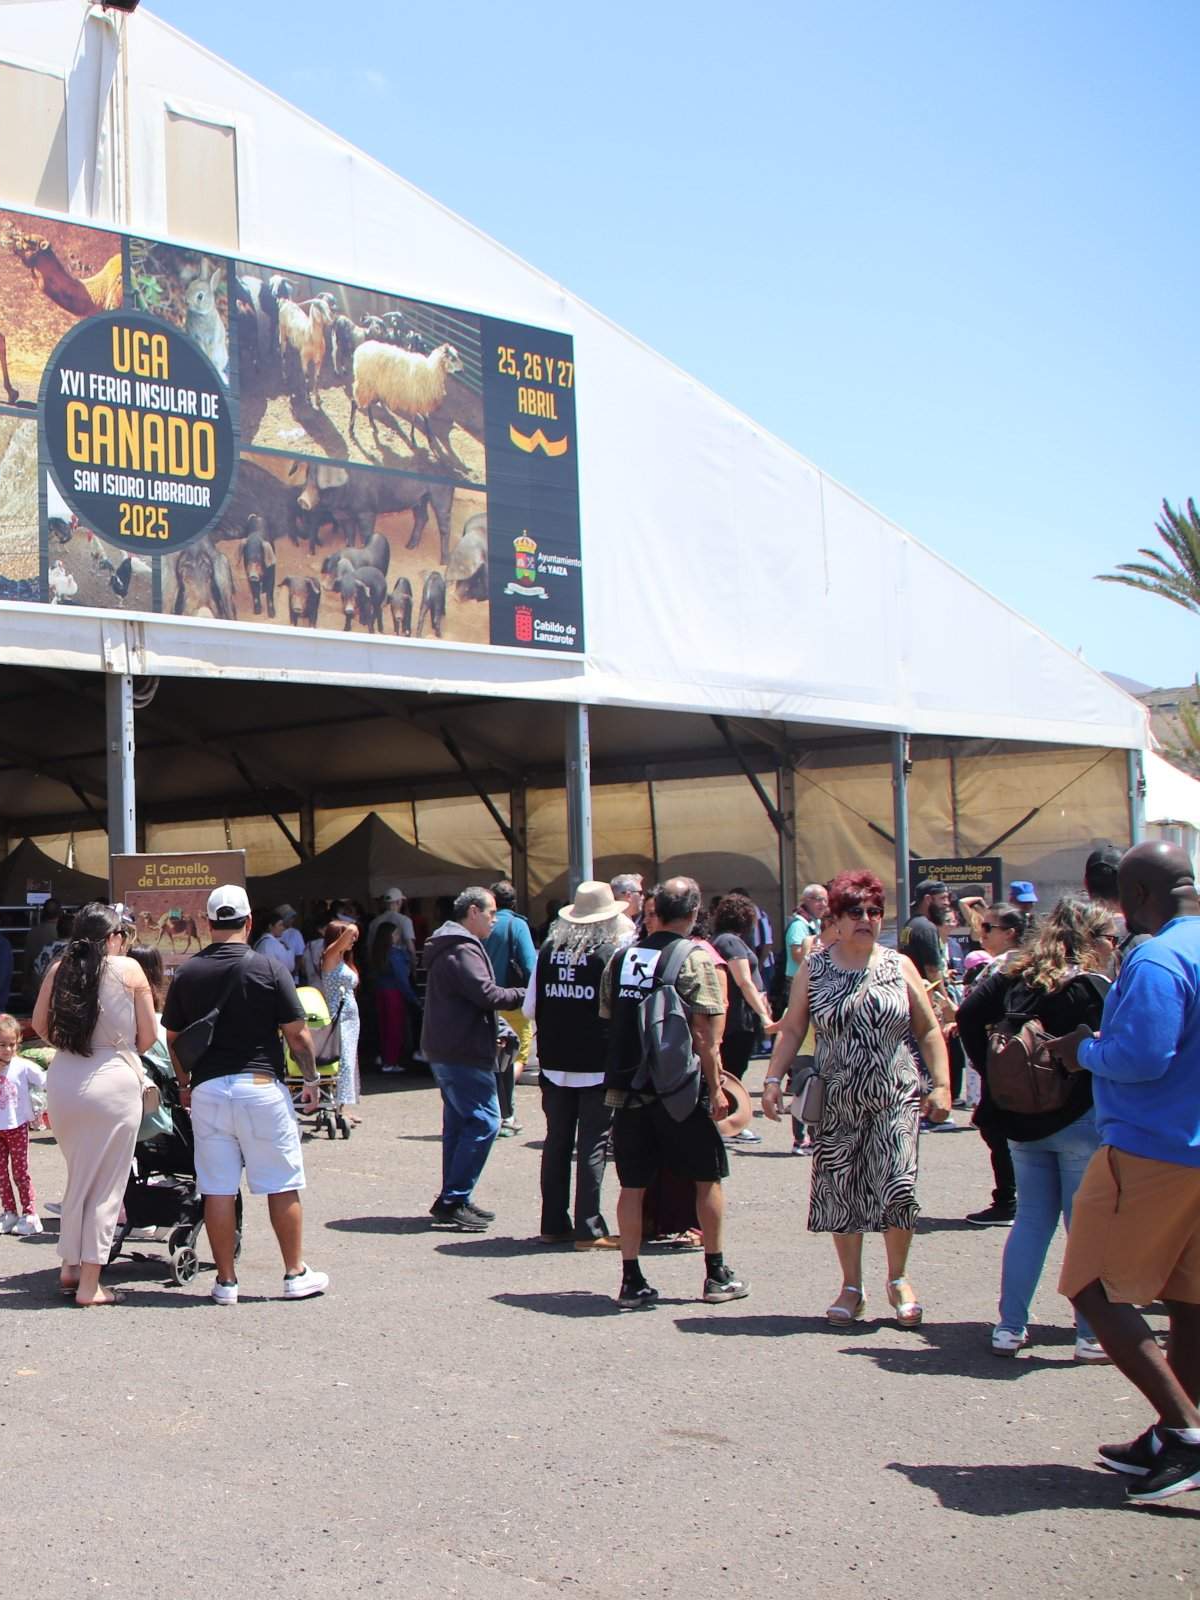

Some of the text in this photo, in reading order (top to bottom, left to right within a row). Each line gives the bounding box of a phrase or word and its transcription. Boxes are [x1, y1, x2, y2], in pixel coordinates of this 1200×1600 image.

[112, 326, 169, 380] UGA
[497, 346, 573, 388] 25, 26 Y 27
[60, 368, 219, 419] XVI FERIA INSULAR DE
[518, 386, 558, 420] ABRIL
[66, 401, 216, 480] GANADO
[74, 470, 211, 508] SAN ISIDRO LABRADOR
[119, 503, 169, 540] 2025
[538, 552, 582, 567] Ayuntamiento
[538, 564, 568, 576] de YAIZA
[534, 619, 576, 635] Cabildo de
[534, 630, 574, 645] Lanzarote
[145, 863, 209, 875] El Camello
[918, 864, 992, 874] El Cochino Negro
[138, 875, 217, 887] de Lanzarote
[558, 967, 575, 981] DE
